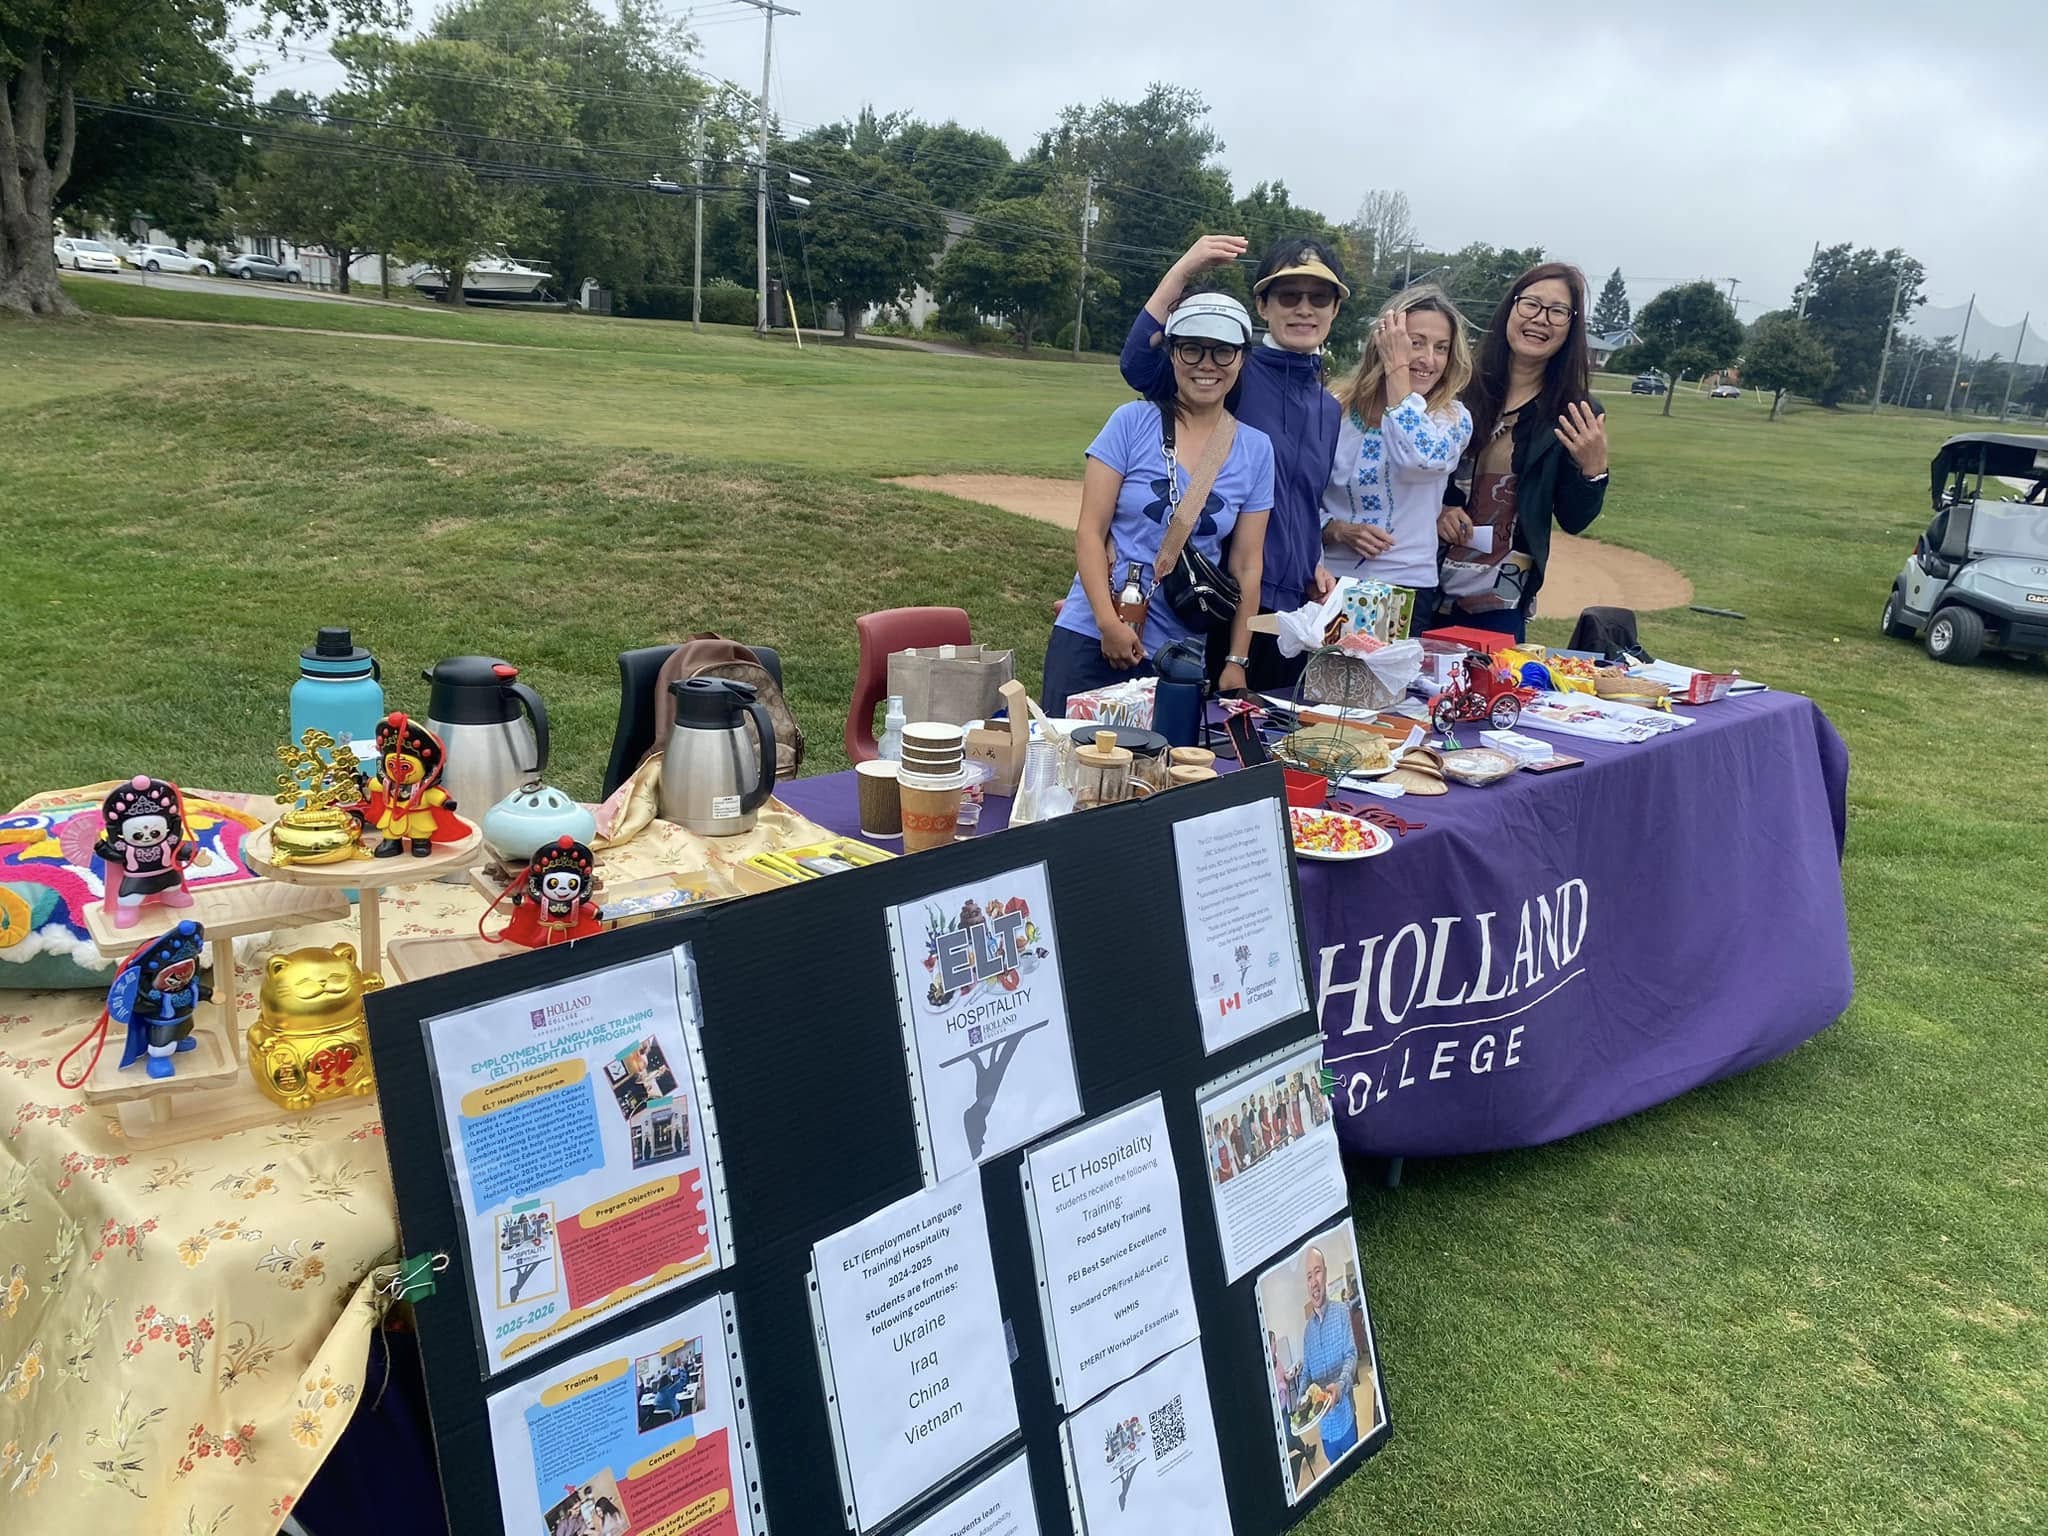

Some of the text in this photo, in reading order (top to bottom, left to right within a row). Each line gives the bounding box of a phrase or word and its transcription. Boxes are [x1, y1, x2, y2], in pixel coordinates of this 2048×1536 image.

[936, 911, 1025, 994] ELT
[1318, 878, 1589, 1038] HOLLAND
[1246, 977, 1276, 995] Government
[1247, 989, 1273, 1004] of Canada
[546, 995, 591, 1017] HOLLAND
[548, 1012, 578, 1025] COLLEGE
[947, 989, 1031, 1034] HOSPITALITY
[983, 1013, 1017, 1034] HOLLAND
[471, 1008, 653, 1073] EMPLOYMENT LANGUAGE TRAINING
[490, 1023, 641, 1080] (ELT) HOSPITALITY PROGRAM
[484, 1068, 558, 1095] Community Education
[1346, 1024, 1525, 1117] OLLEGE
[467, 1116, 496, 1131] provides
[514, 1097, 551, 1113] immigrants
[561, 1085, 585, 1096] Canada
[482, 1079, 564, 1111] ELT Hospitality Program
[467, 1136, 487, 1147] status
[534, 1112, 553, 1122] under
[469, 1125, 493, 1137] (Levels
[505, 1115, 520, 1124] with
[521, 1102, 557, 1120] permanent
[558, 1092, 585, 1105] resident
[498, 1138, 526, 1152] learning
[527, 1128, 551, 1141] English
[553, 1123, 565, 1131] and
[566, 1114, 593, 1126] learning
[508, 1130, 524, 1140] with
[529, 1140, 544, 1148] help
[499, 1156, 520, 1168] Prince
[521, 1146, 547, 1159] Edward
[548, 1137, 568, 1149] Island
[548, 1157, 563, 1166] June
[1051, 1135, 1151, 1192] ELT Hospitality
[483, 1185, 508, 1200] Holland
[509, 1176, 534, 1189] College
[535, 1164, 563, 1179] Belmont
[564, 1156, 585, 1168] Centre
[1055, 1158, 1157, 1213] students receive the following
[596, 1186, 664, 1216] Program Objectives
[1082, 1196, 1122, 1221] Training:
[508, 1215, 545, 1247] ELT
[843, 1203, 962, 1271] ELT (Employment Language
[1077, 1204, 1151, 1246] Food Safety Training
[506, 1244, 548, 1262] HOSPITALITY
[862, 1227, 949, 1279] Training) Hospitality
[1067, 1227, 1166, 1283] PEI Best Service Excellence
[888, 1256, 932, 1287] 2024-2025
[1070, 1255, 1168, 1314] Standard CPR/First Aid-Level C
[865, 1263, 958, 1320] students are from the
[872, 1282, 957, 1335] following countries:
[496, 1302, 554, 1338] 2025-2026
[1114, 1300, 1139, 1319] WHMIS
[893, 1314, 945, 1351] Ukraine
[1080, 1309, 1179, 1371] EMERIT Workplace Essentials
[911, 1351, 938, 1375] Iraq
[564, 1374, 598, 1390] Training
[909, 1377, 949, 1408] China
[905, 1402, 962, 1444] Vietnam
[1109, 1423, 1137, 1455] ELT
[648, 1448, 675, 1466] Contact
[657, 1523, 665, 1532] to
[666, 1511, 684, 1528] study
[685, 1500, 709, 1517] further
[709, 1496, 717, 1504] in
[668, 1527, 676, 1535] or
[677, 1503, 716, 1530] Accounting?
[981, 1502, 1001, 1520] learn
